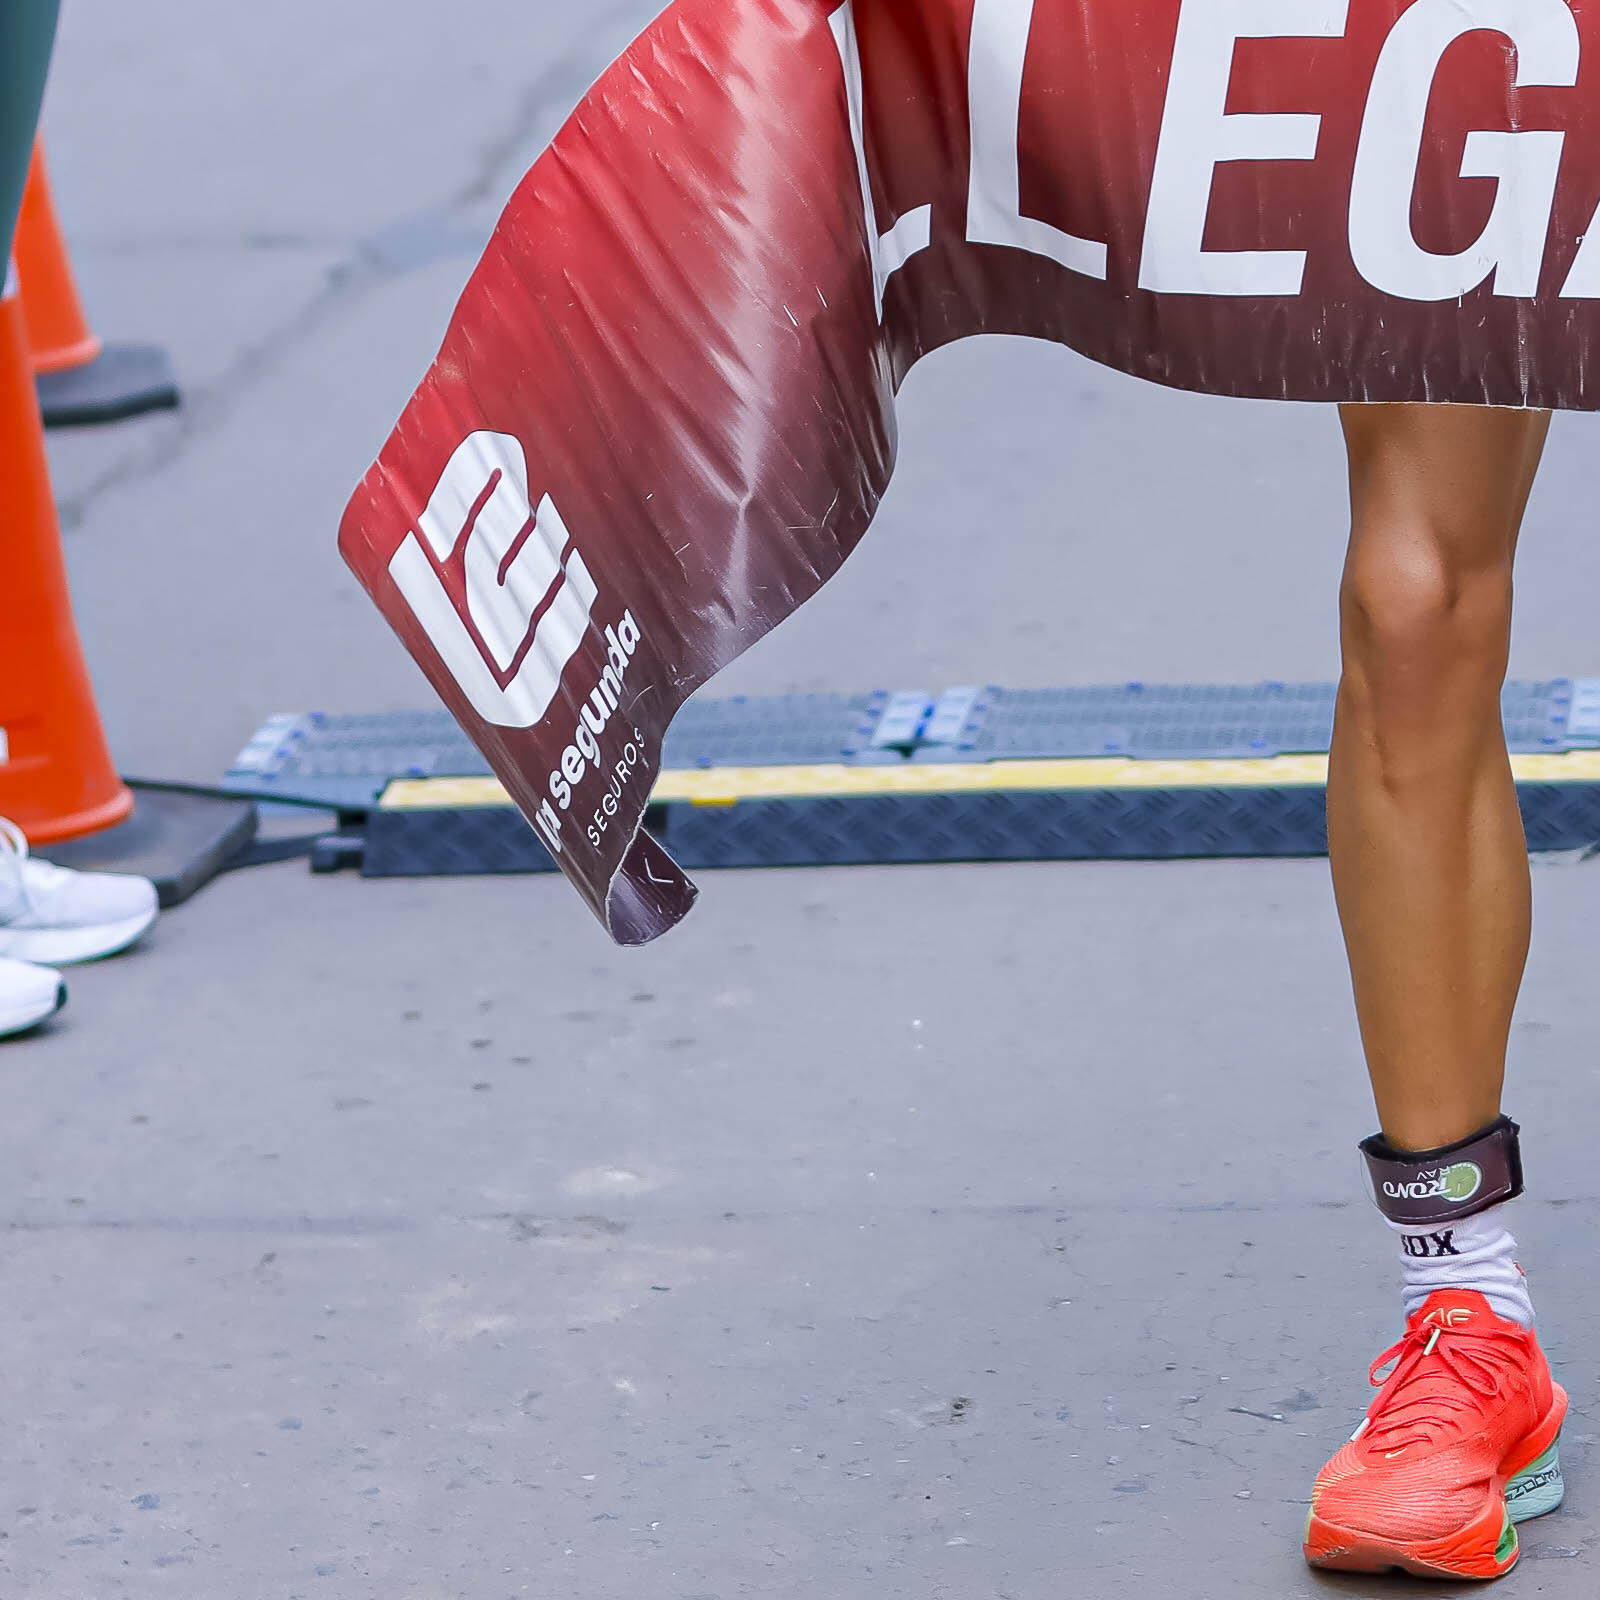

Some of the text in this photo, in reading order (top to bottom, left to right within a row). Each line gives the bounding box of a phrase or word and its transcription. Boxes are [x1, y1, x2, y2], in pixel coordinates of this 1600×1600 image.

[548, 607, 641, 810] segunda
[587, 727, 646, 847] SEGUROS
[1401, 1229, 1463, 1258] OX
